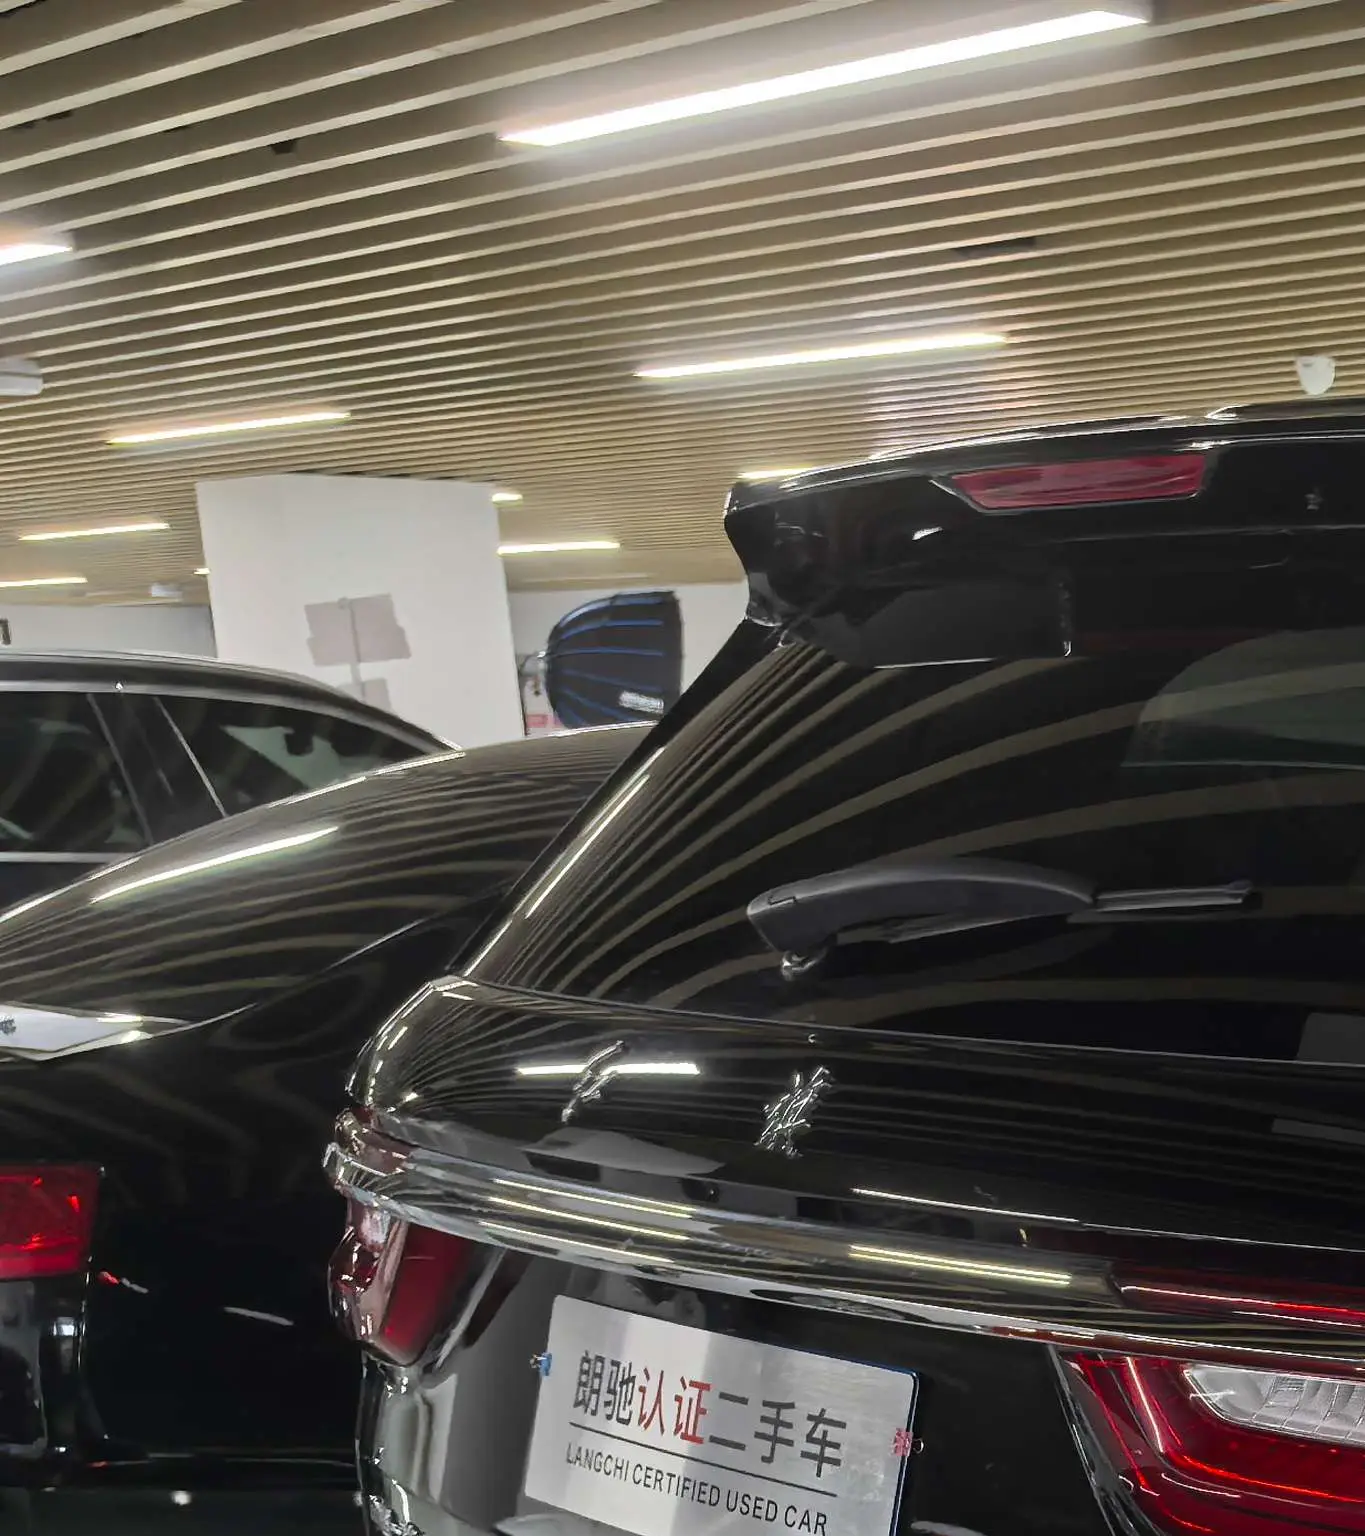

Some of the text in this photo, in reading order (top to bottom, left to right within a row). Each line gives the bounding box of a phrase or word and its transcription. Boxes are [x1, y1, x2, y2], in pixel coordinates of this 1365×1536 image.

[573, 1350, 848, 1478] 朗驰认证二手车
[565, 1443, 828, 1536] LANGCHI CERTIFIED USED CAR
